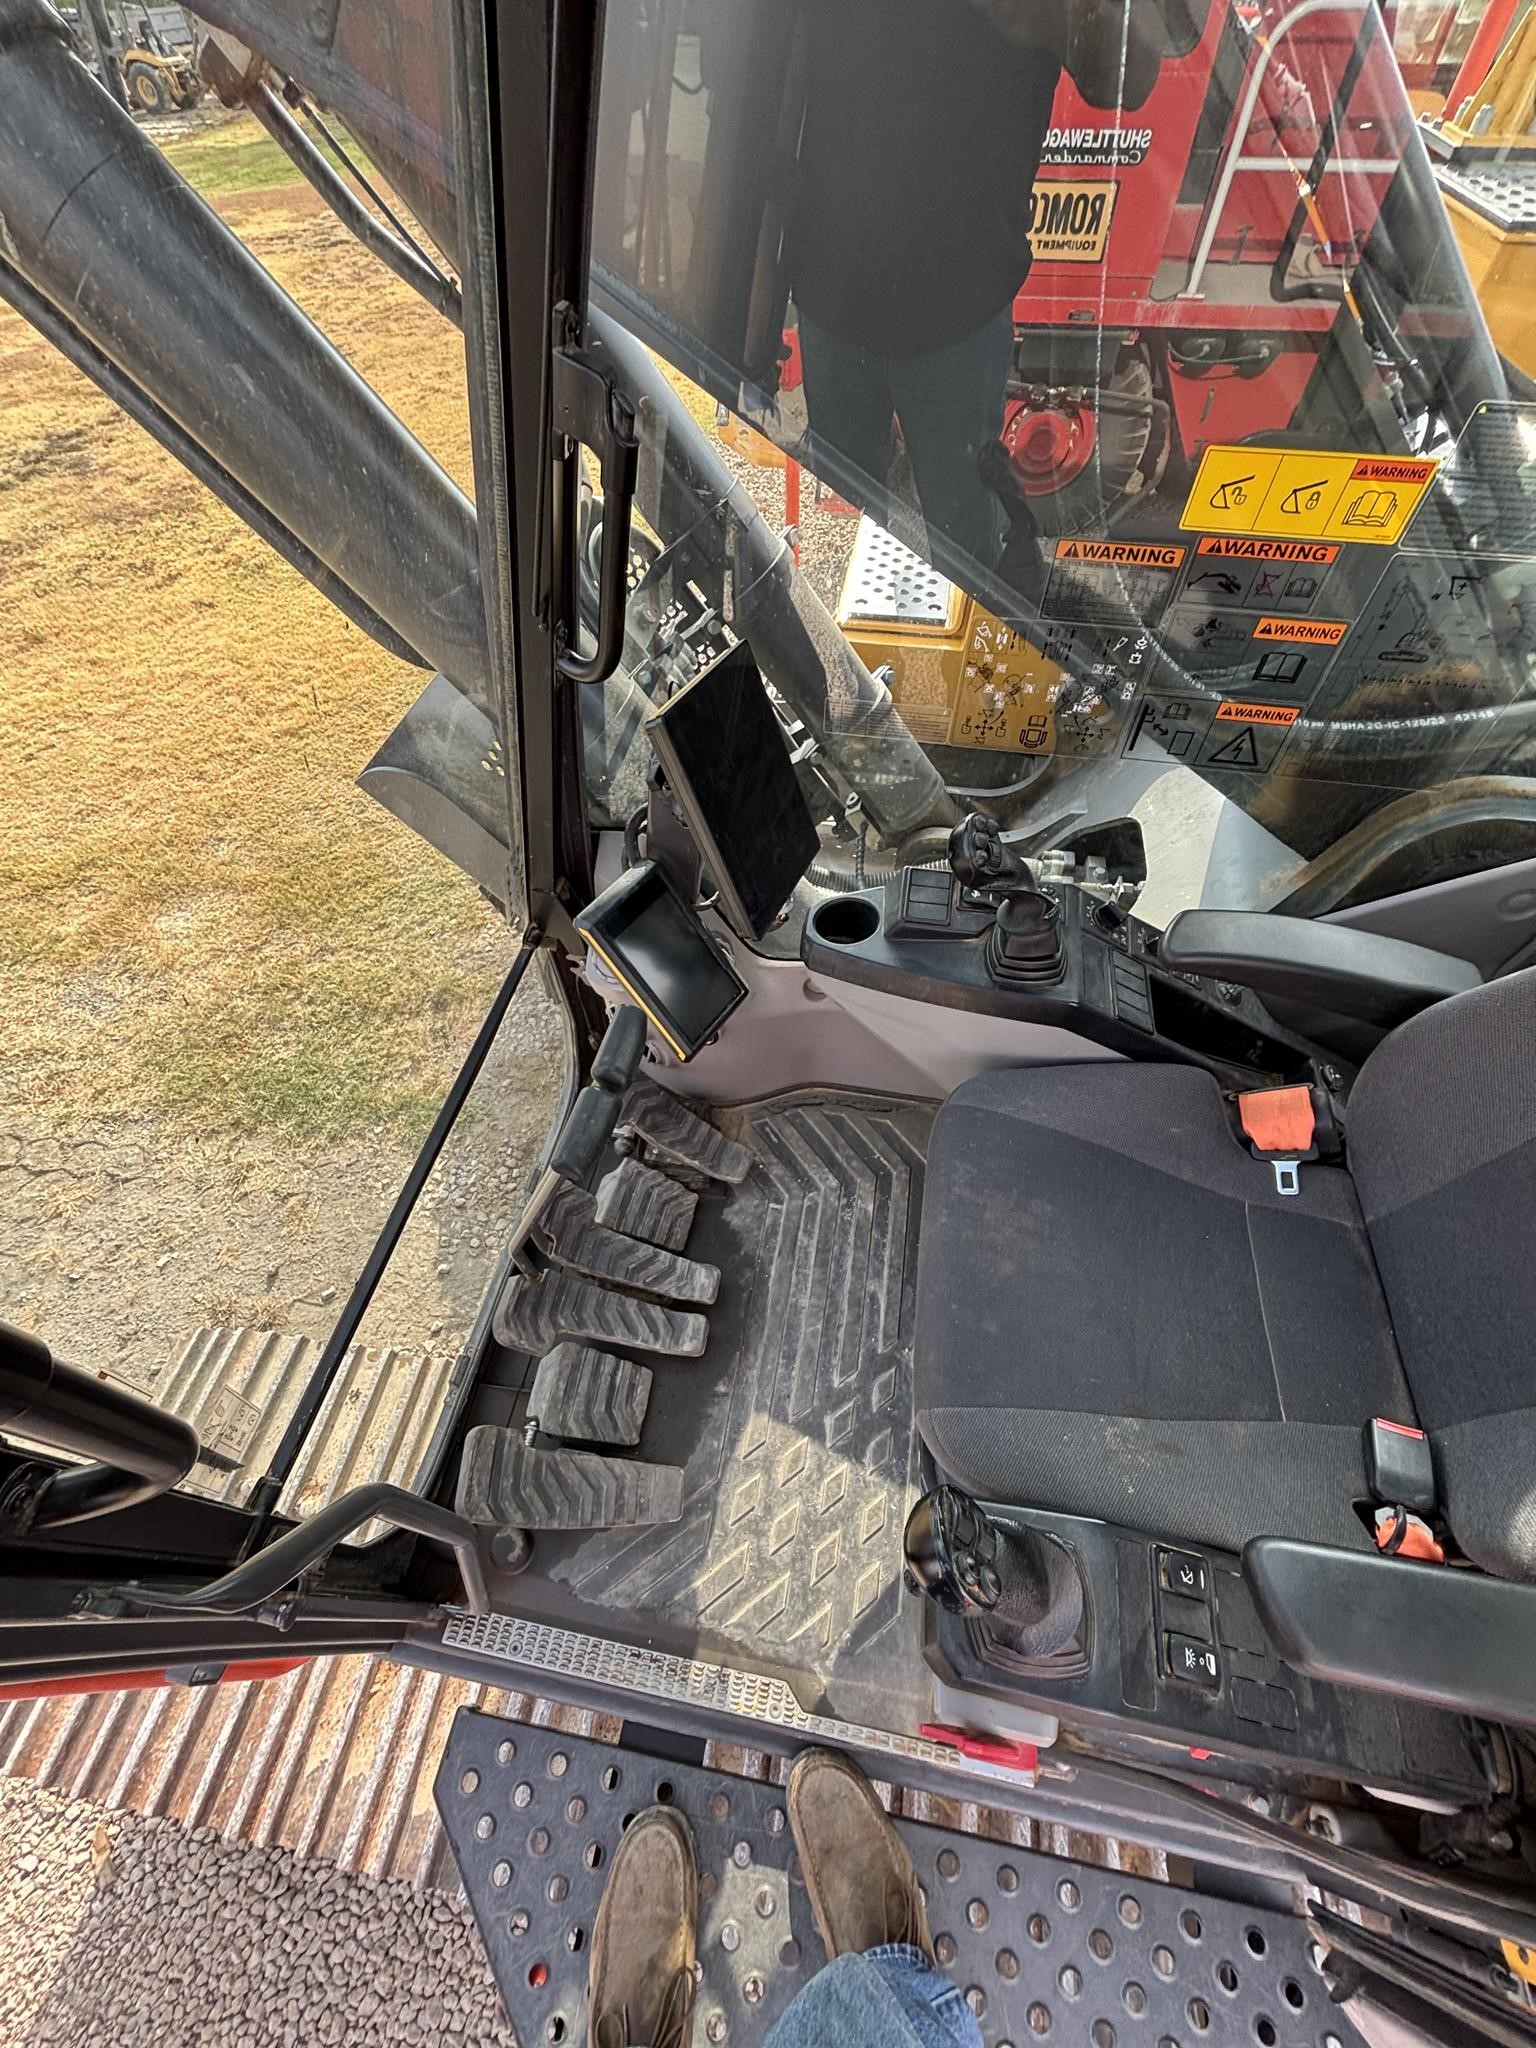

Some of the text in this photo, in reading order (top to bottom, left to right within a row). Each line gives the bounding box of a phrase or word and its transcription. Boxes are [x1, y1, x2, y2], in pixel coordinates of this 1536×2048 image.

[1370, 465, 1429, 480] WARNING
[1082, 544, 1177, 564] WARNING
[1224, 540, 1329, 561] WARNING
[1273, 624, 1342, 640] WARNING
[1234, 707, 1294, 722] WARNING
